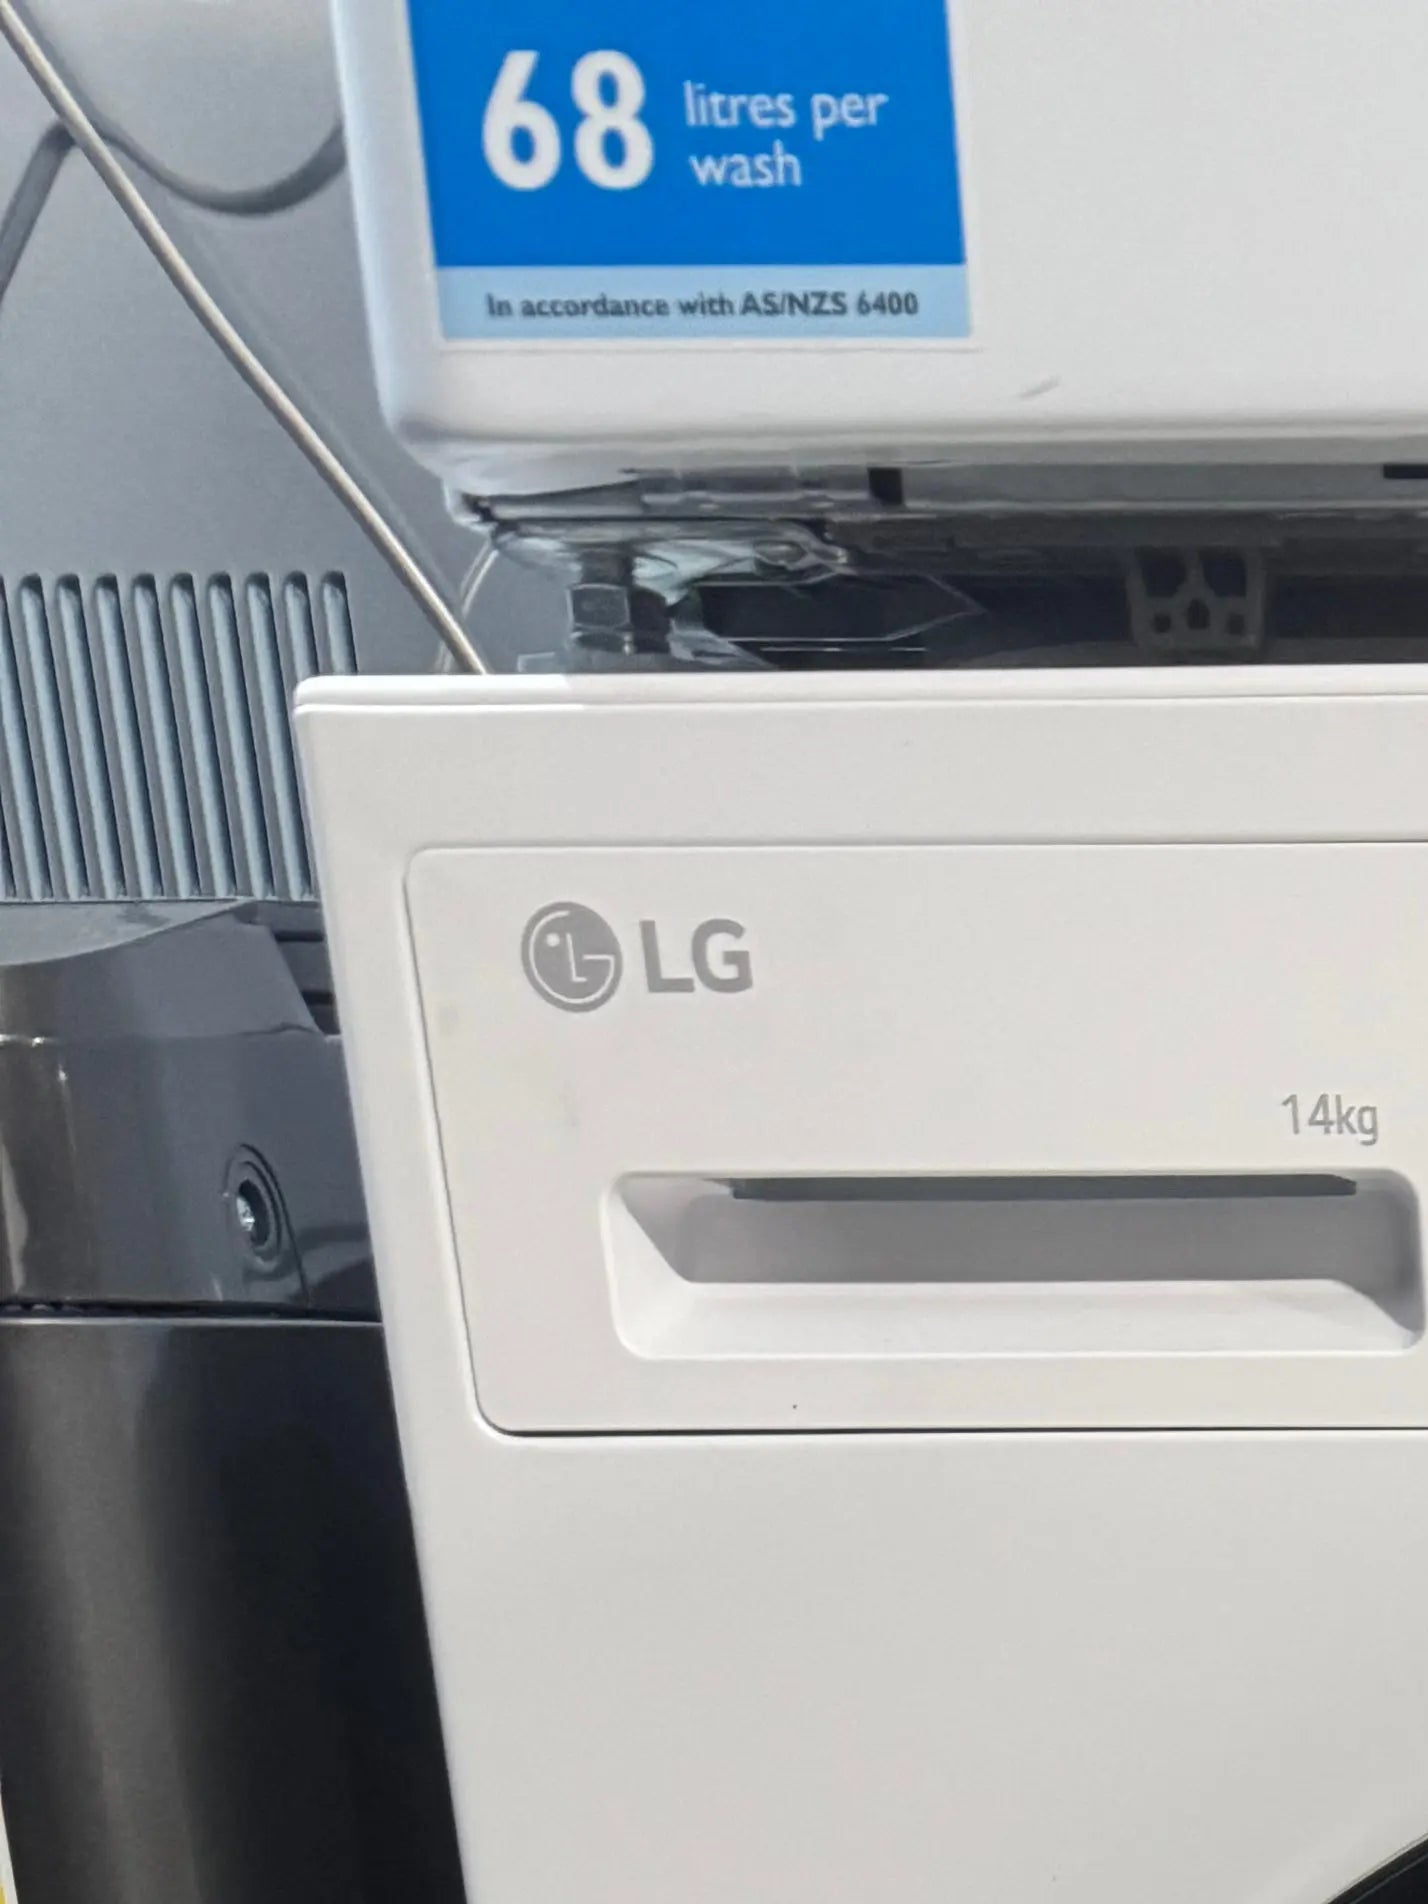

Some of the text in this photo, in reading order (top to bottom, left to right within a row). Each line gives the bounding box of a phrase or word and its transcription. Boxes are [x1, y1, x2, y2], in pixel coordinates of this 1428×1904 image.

[483, 50, 654, 191] 68
[683, 81, 889, 140] litres per
[689, 141, 801, 187] wash
[488, 289, 919, 318] In accordance with AS/NZS 6400
[640, 919, 753, 994] LG
[1281, 1093, 1379, 1146] 14kg
